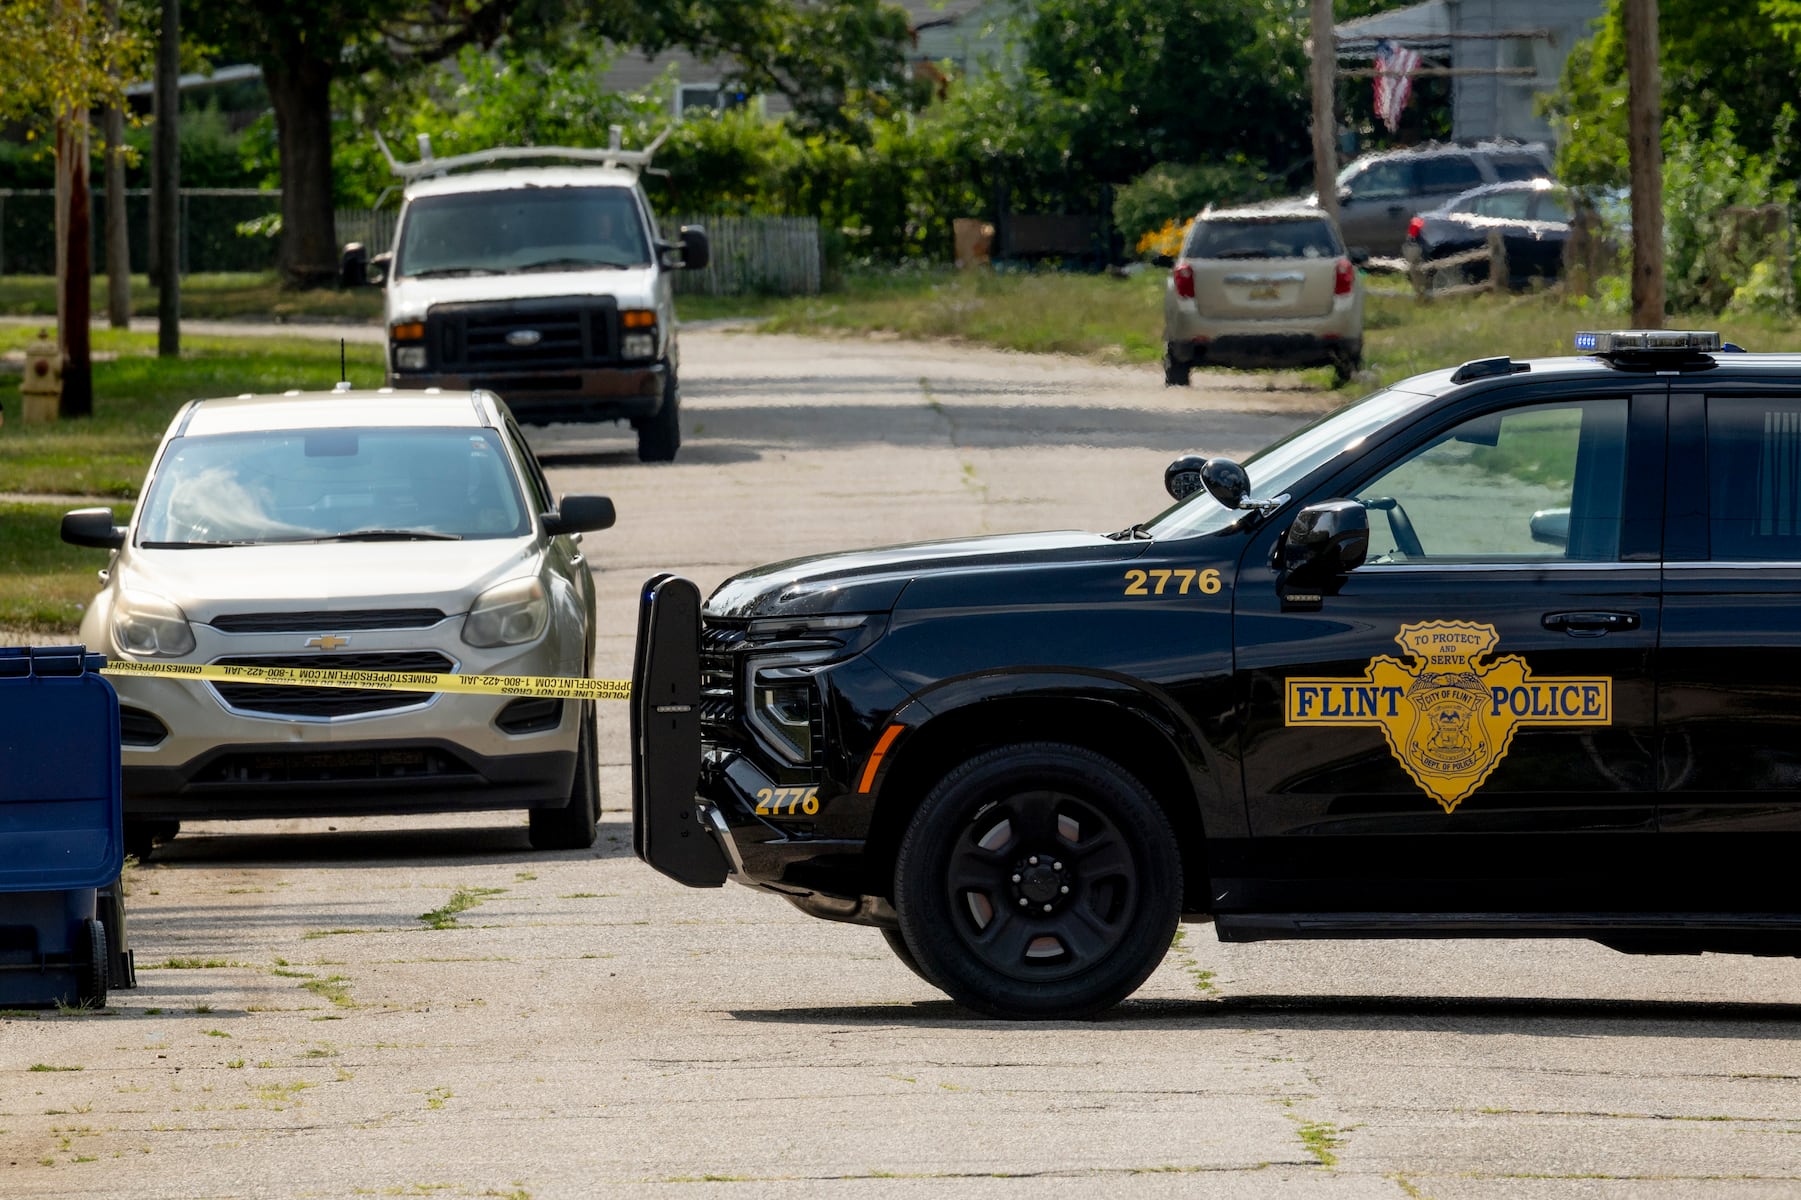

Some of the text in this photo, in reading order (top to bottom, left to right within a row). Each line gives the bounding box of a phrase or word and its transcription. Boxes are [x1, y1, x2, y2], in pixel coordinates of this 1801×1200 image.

[1124, 568, 1222, 596] 2776
[1414, 633, 1481, 646] TO PROTECT
[1439, 645, 1457, 653] AND
[1430, 655, 1466, 665] SERVE
[223, 666, 438, 685] CRIMESTOPPERSOFFLINT.COM 1-800-422-JAIL
[458, 675, 530, 687] 1-800-422-JAIL
[500, 687, 630, 700] POLICE LINE DO NOT CROSS
[1424, 690, 1473, 704] CITY OF FLINT
[1296, 685, 1601, 717] FLINT POLICE
[1424, 757, 1474, 771] DEPT. OF POLICE
[755, 787, 820, 816] 2776
